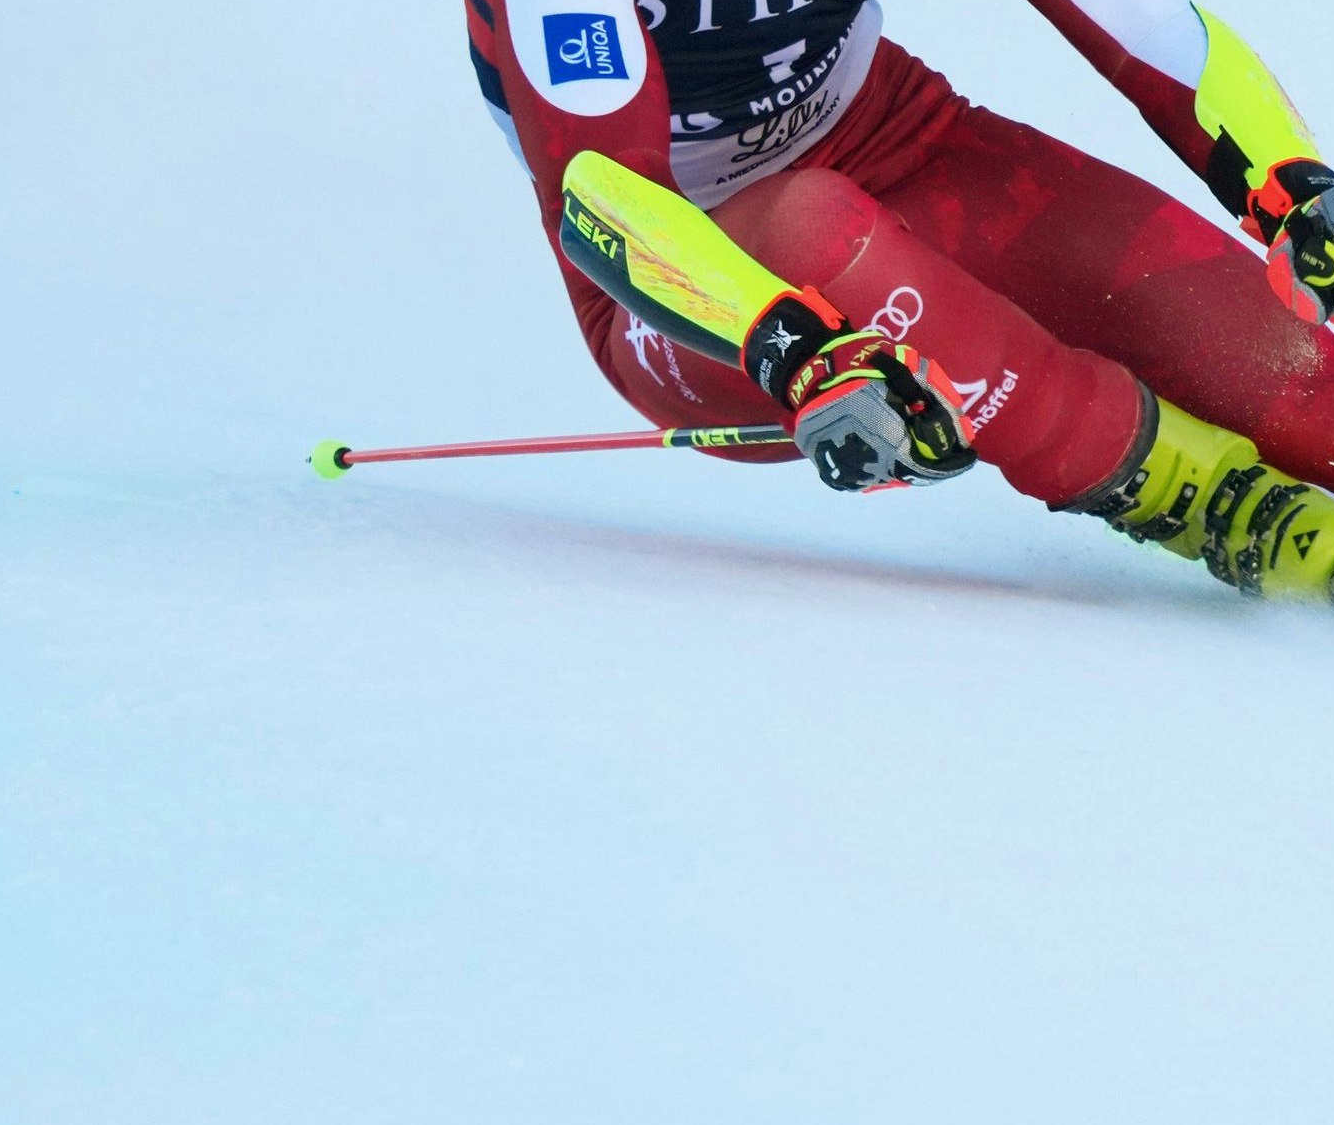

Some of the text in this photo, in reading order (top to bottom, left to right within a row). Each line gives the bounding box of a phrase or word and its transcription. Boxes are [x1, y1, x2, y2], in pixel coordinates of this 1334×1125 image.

[590, 19, 615, 75] UNIQA
[731, 89, 829, 164] Lilly
[565, 196, 618, 260] LEKI
[971, 369, 1019, 434] höffel
